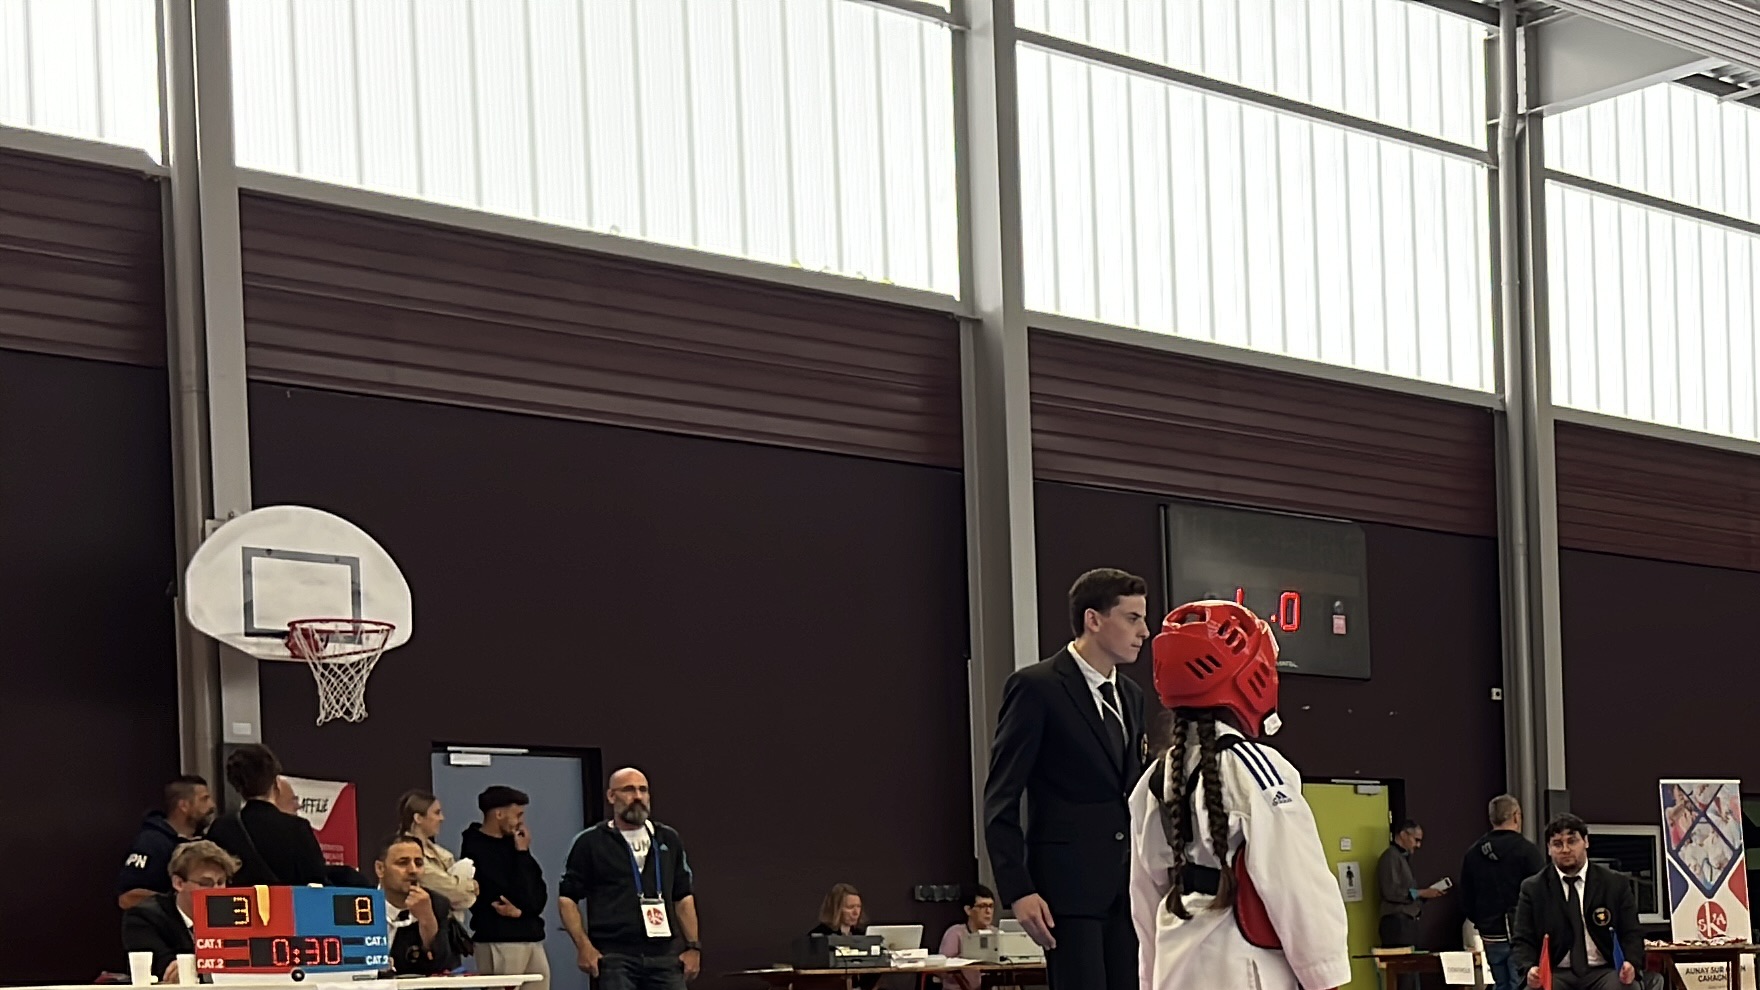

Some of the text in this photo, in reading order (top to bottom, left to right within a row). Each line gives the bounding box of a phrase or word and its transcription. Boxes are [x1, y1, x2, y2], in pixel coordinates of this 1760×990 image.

[233, 896, 250, 925] 3
[355, 896, 372, 924] 8
[196, 938, 222, 949] CAT.1
[365, 936, 387, 946] CAT.1
[272, 938, 341, 965] 0:30
[197, 959, 224, 969] CAT.2
[365, 955, 389, 965] CAT.2
